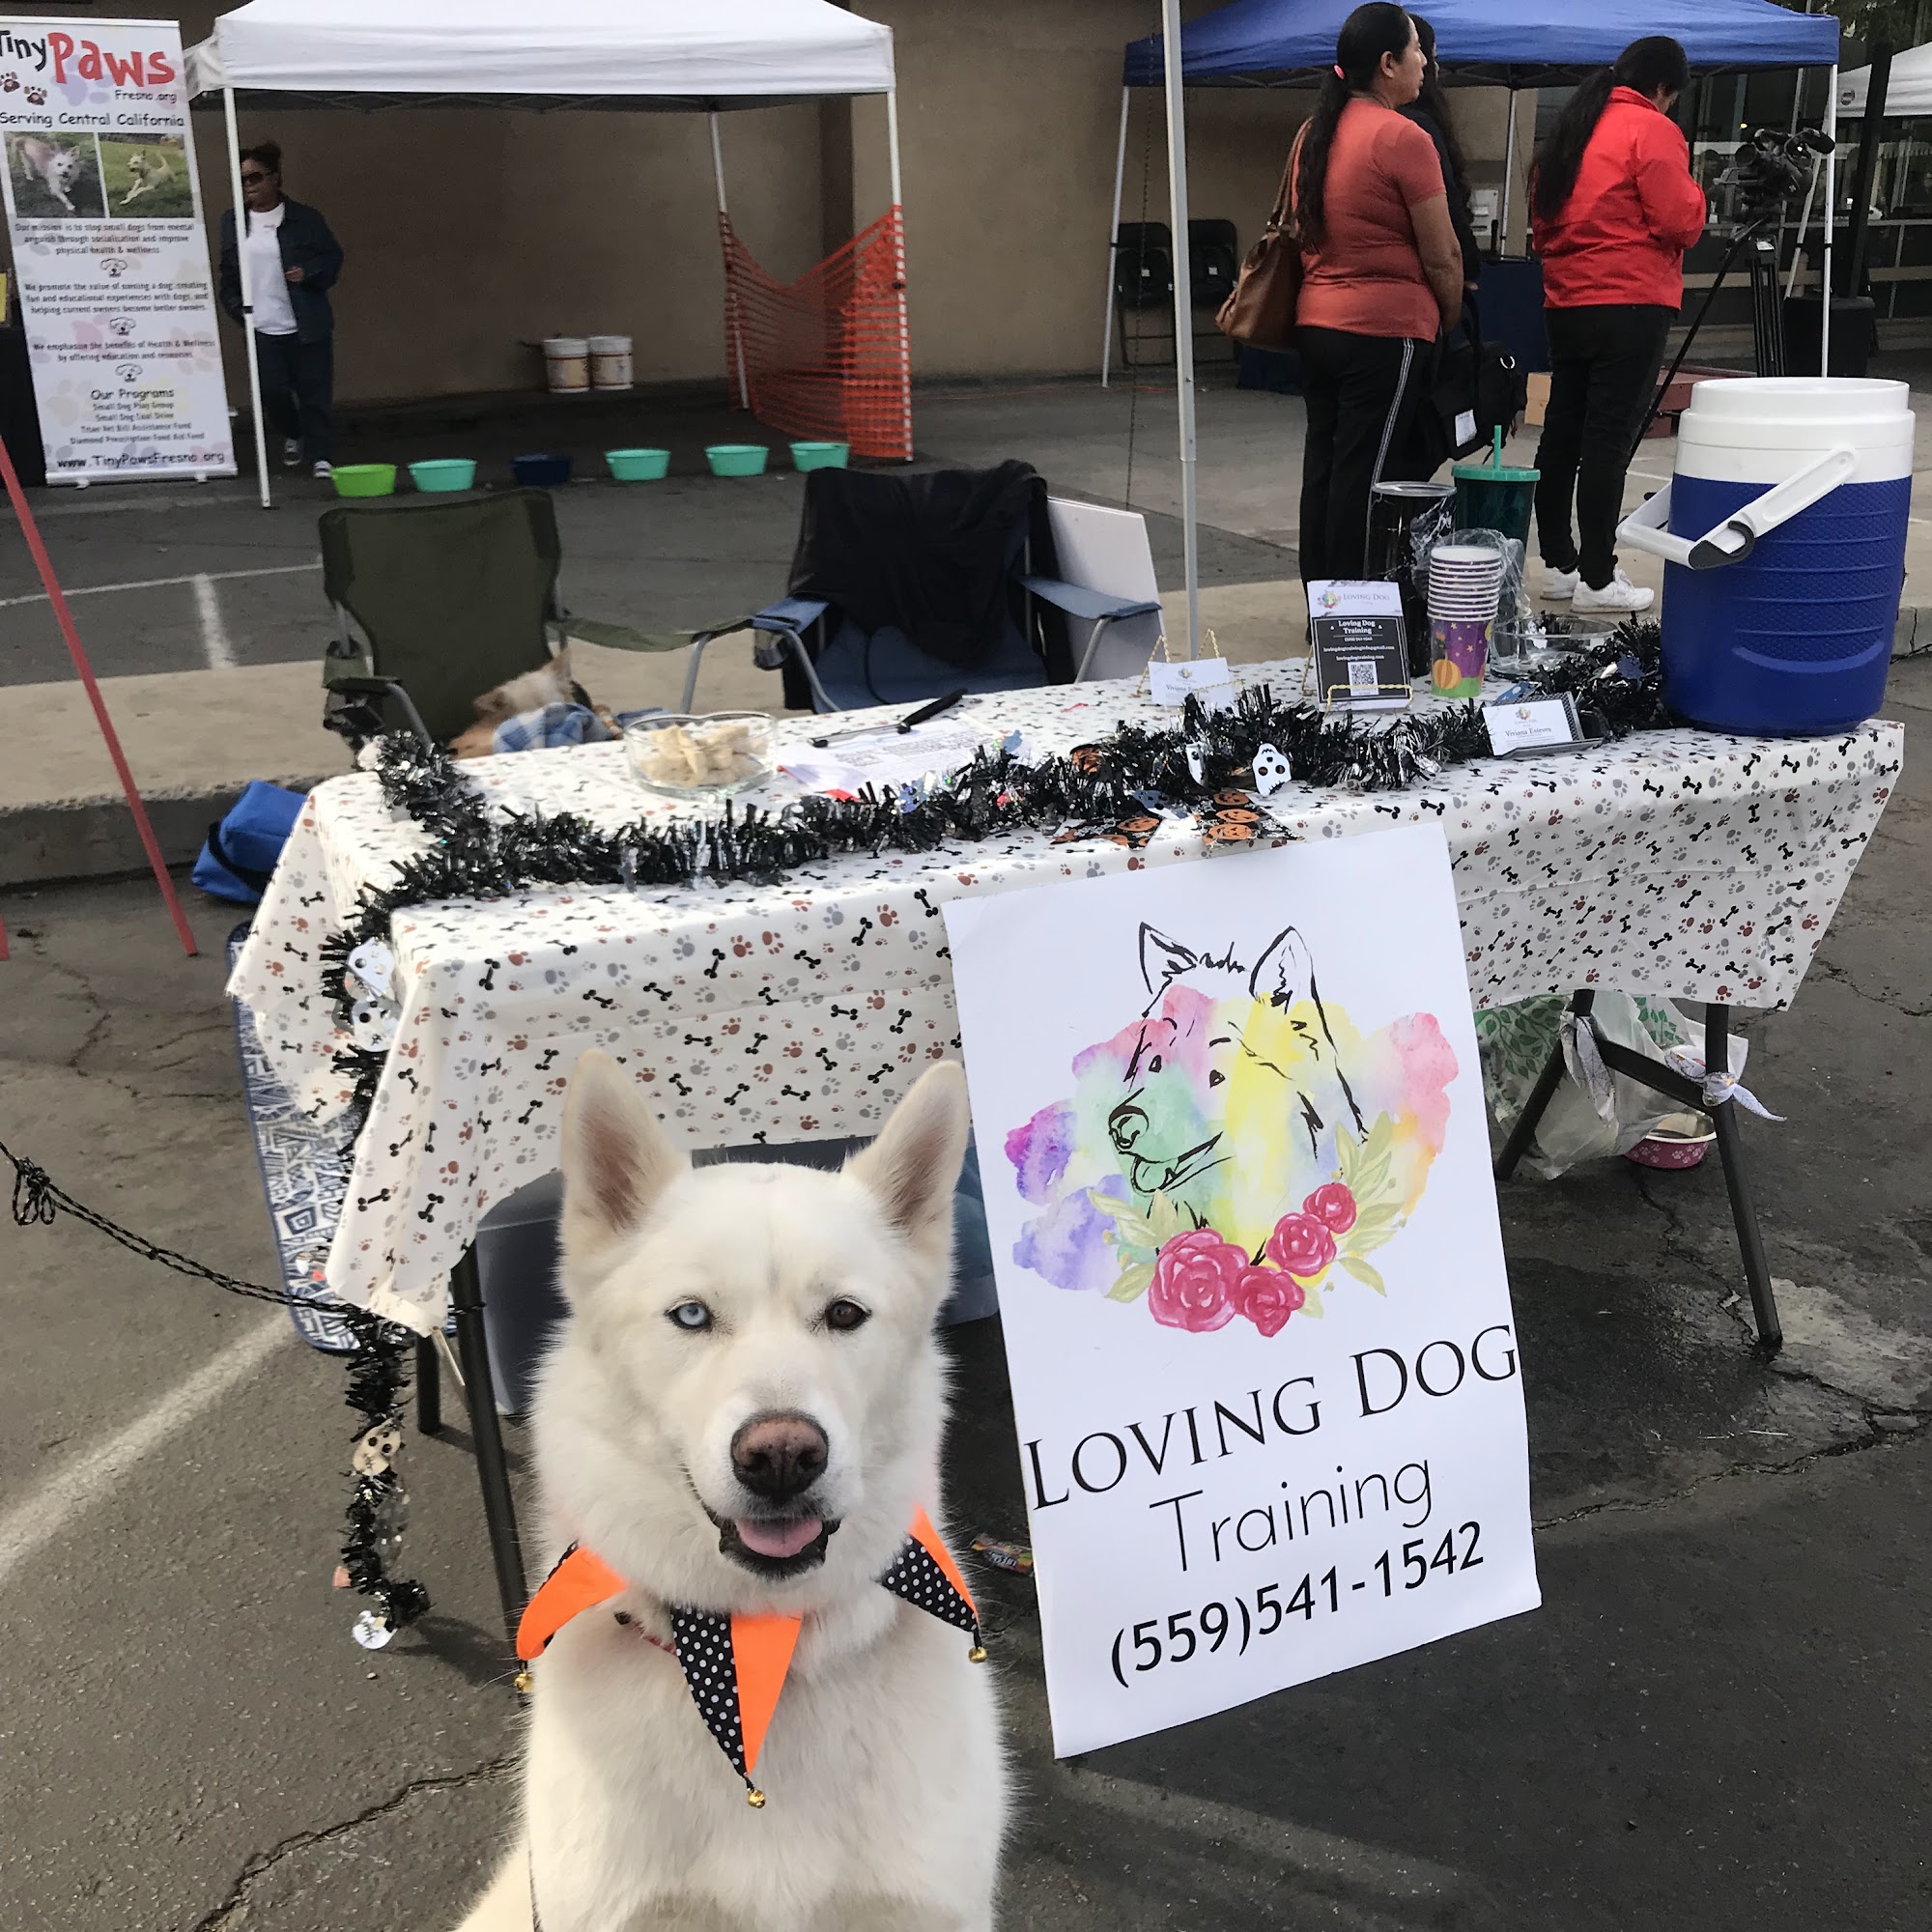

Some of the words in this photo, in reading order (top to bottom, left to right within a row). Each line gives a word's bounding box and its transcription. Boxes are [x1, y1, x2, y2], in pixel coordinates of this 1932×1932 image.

[0, 112, 53, 128] Serving
[59, 112, 110, 126] Central
[117, 114, 185, 127] California
[91, 389, 114, 400] Our
[119, 388, 174, 402] Programs
[57, 452, 224, 469] www.TinyPawsFresno.org
[1022, 1376, 1322, 1512] LOVING
[1349, 1324, 1517, 1418] DOG
[1149, 1459, 1433, 1573] Training
[1111, 1520, 1485, 1690] (559)541-1542
